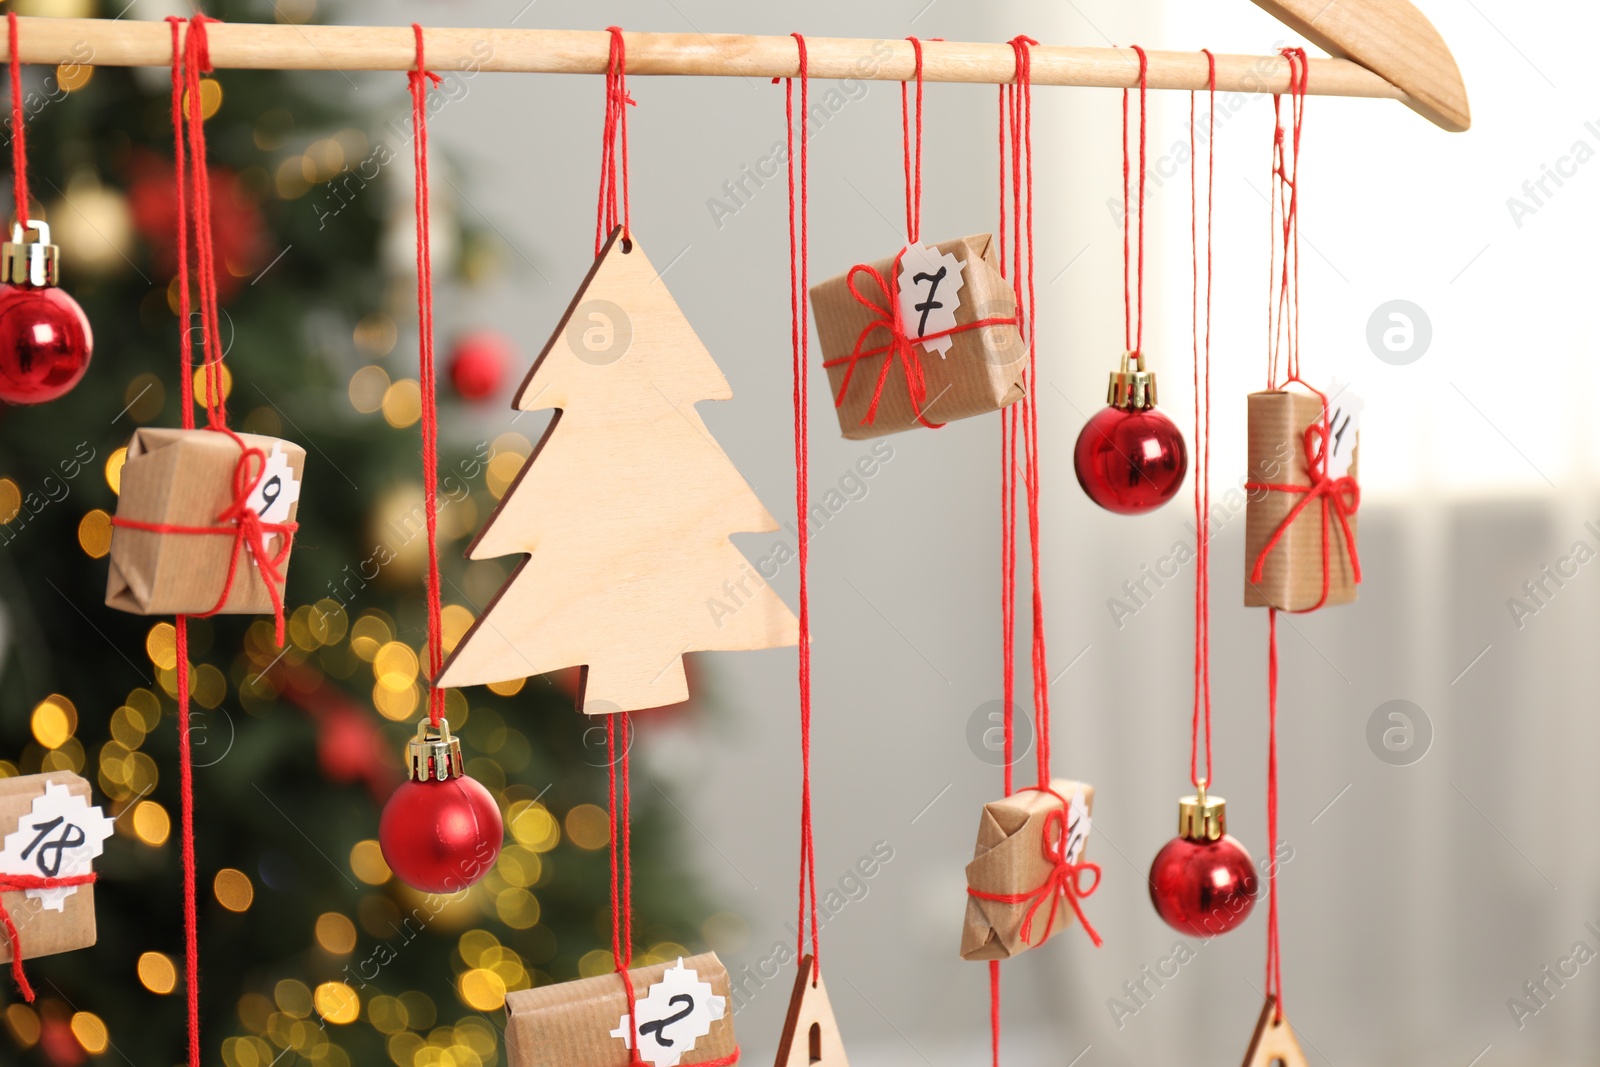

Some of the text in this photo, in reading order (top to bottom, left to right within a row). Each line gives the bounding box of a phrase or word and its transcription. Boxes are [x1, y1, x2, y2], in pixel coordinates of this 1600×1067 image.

[913, 266, 946, 338] 7
[258, 474, 282, 518] 9
[21, 815, 85, 877] 18
[639, 993, 694, 1047] 2
